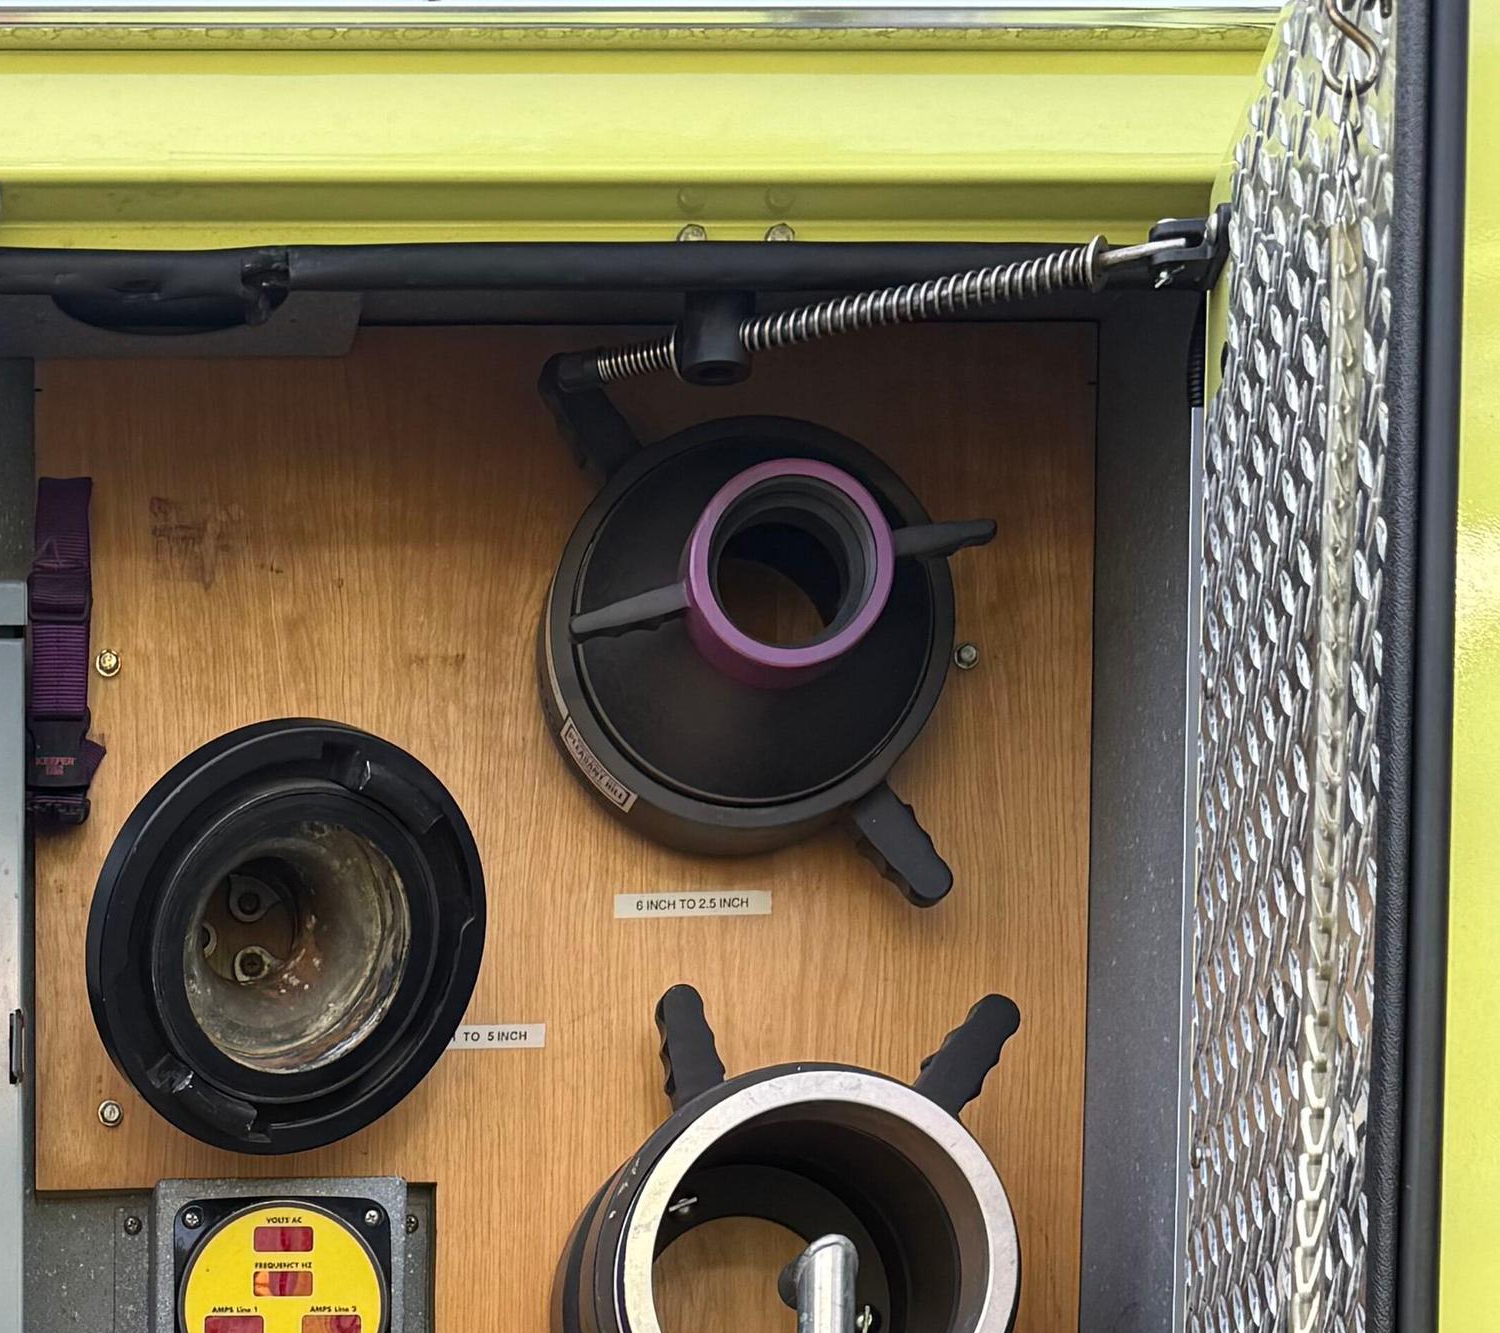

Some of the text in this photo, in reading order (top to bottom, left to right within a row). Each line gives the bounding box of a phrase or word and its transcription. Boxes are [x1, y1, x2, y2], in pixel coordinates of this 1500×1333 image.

[635, 897, 749, 912] 6 INCH TO 2.5 INCH
[463, 1031, 481, 1042] TO
[487, 1031, 495, 1041] 5
[497, 1030, 528, 1041] INCH
[211, 1306, 234, 1314] AMPS
[309, 1305, 333, 1313] AMPS
